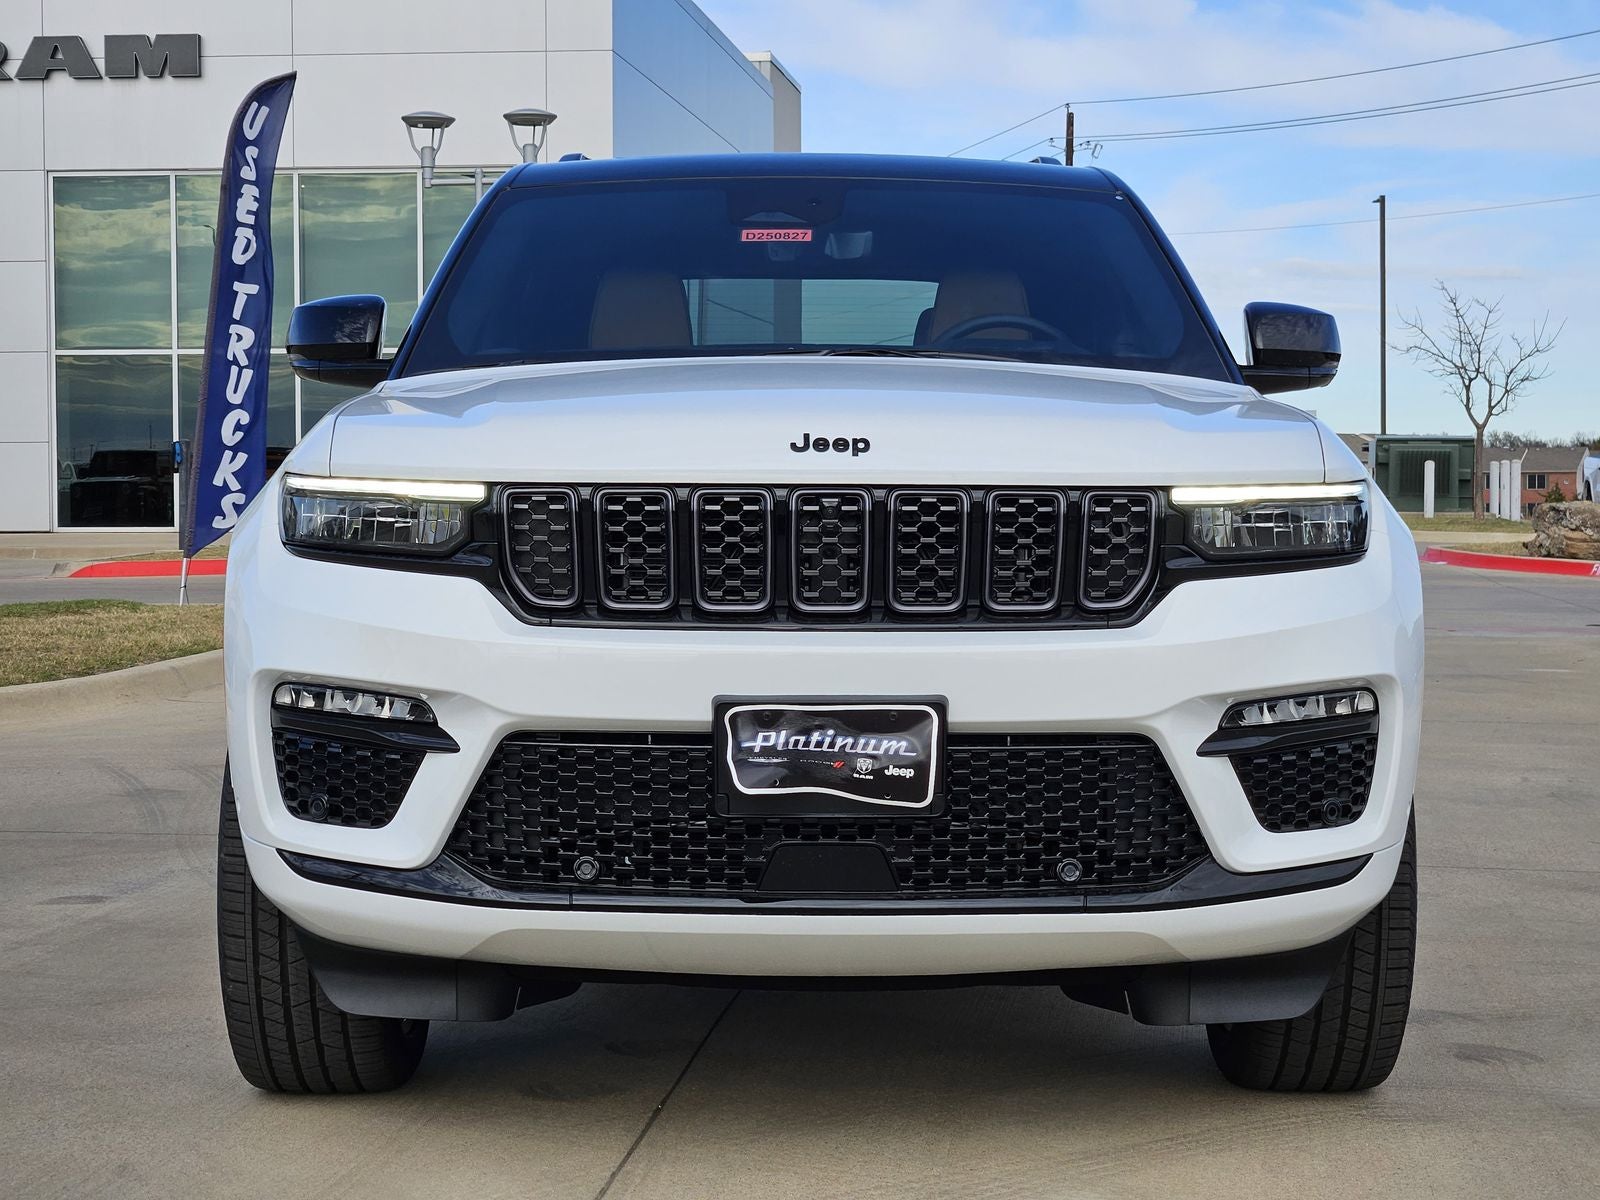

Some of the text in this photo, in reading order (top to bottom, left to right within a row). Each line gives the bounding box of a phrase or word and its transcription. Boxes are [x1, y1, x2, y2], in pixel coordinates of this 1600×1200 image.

[0, 34, 201, 80] AM
[745, 231, 809, 241] D250827
[211, 101, 270, 529] USED TRUCKS
[790, 432, 871, 457] Jeep
[741, 729, 917, 757] Platinum
[884, 764, 915, 779] Jeep
